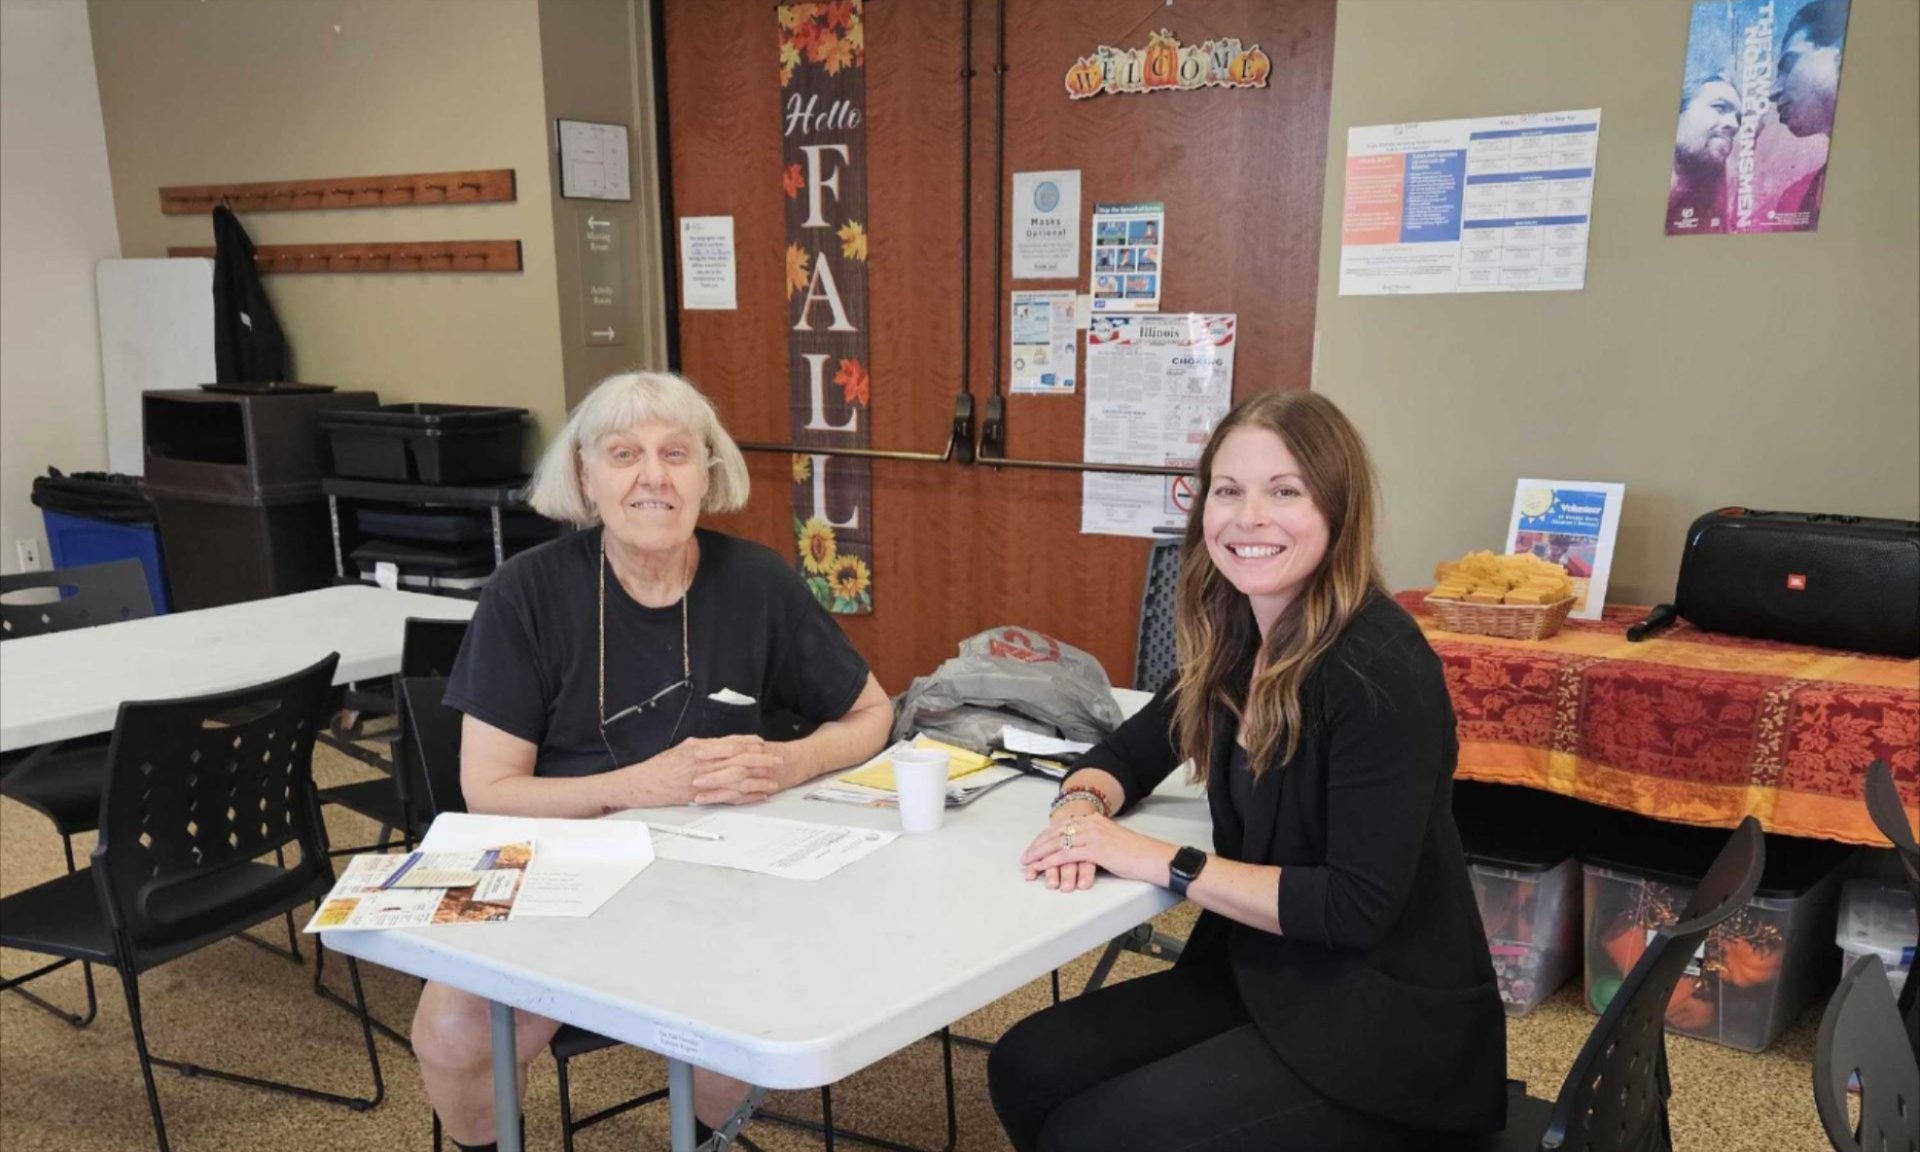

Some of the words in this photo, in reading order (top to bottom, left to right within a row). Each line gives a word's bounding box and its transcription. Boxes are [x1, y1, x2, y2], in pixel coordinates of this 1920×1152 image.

[1758, 0, 1775, 53] THE
[1075, 49, 1256, 90] WELCOME
[1743, 26, 1760, 113] NOBLE
[1756, 52, 1773, 114] TWO
[784, 92, 862, 137] Hello
[1737, 114, 1759, 228] KINSMEN
[1026, 228, 1066, 238] Optional
[1031, 218, 1061, 226] Masks
[792, 143, 859, 529] FALL
[1139, 326, 1180, 338] Illinois
[1561, 503, 1602, 514] Volunteer
